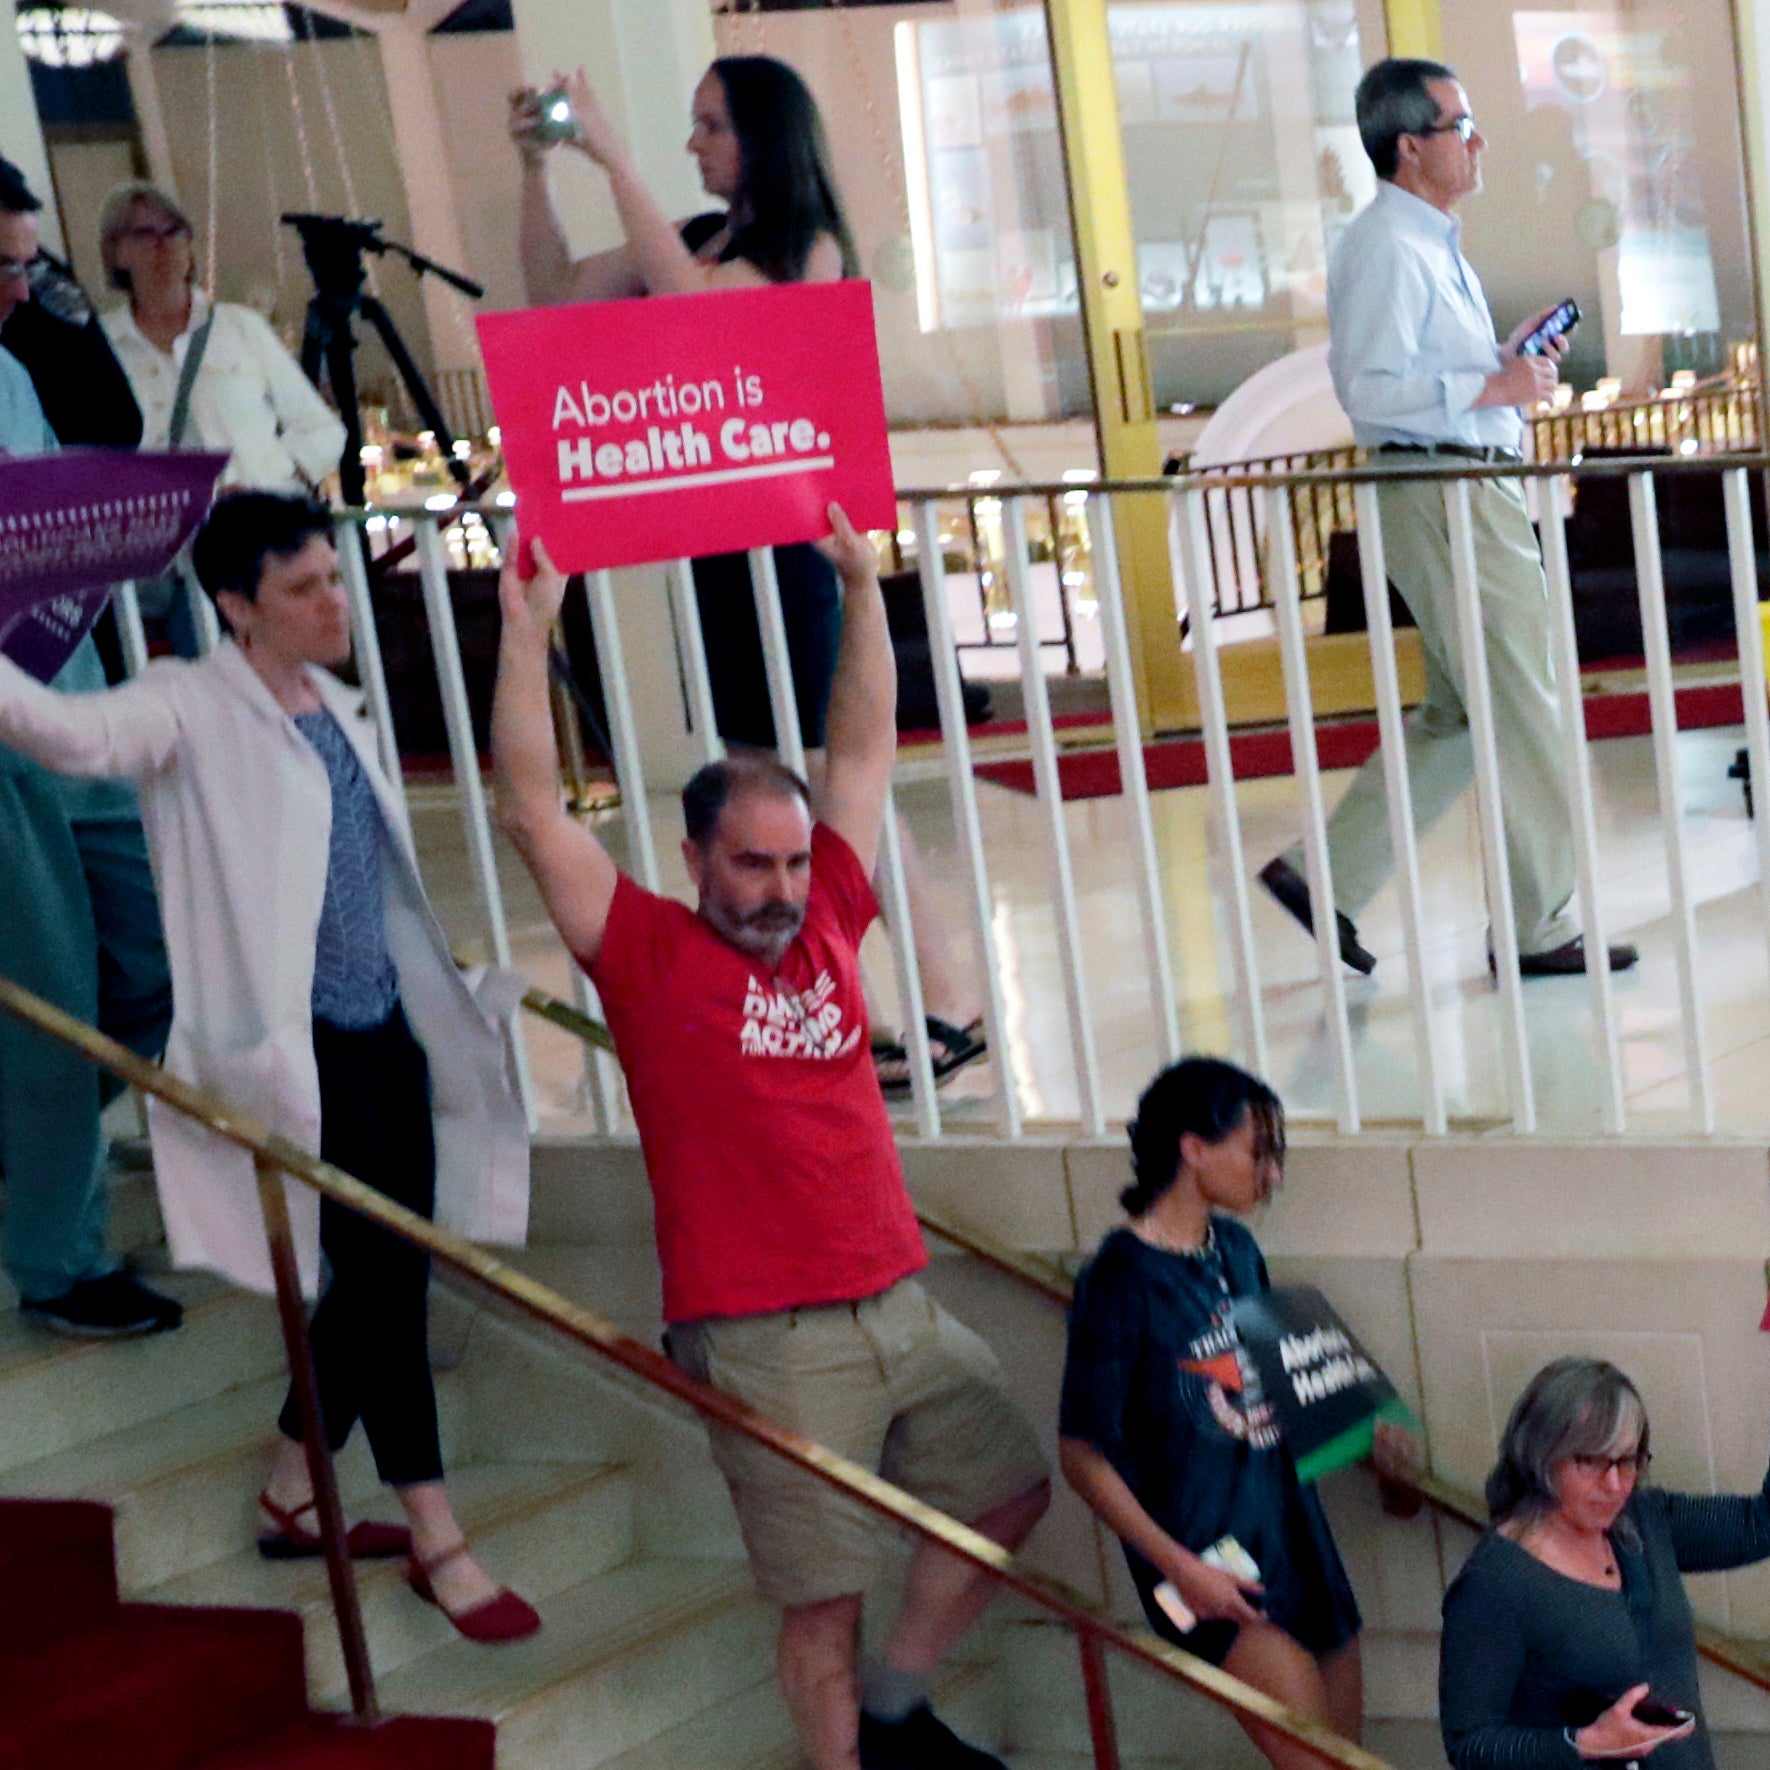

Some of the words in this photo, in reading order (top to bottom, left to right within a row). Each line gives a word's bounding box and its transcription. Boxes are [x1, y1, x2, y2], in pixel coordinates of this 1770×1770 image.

[552, 373, 725, 431] Abortion
[733, 364, 764, 408] is
[557, 421, 713, 483] Health
[719, 416, 831, 461] Care.
